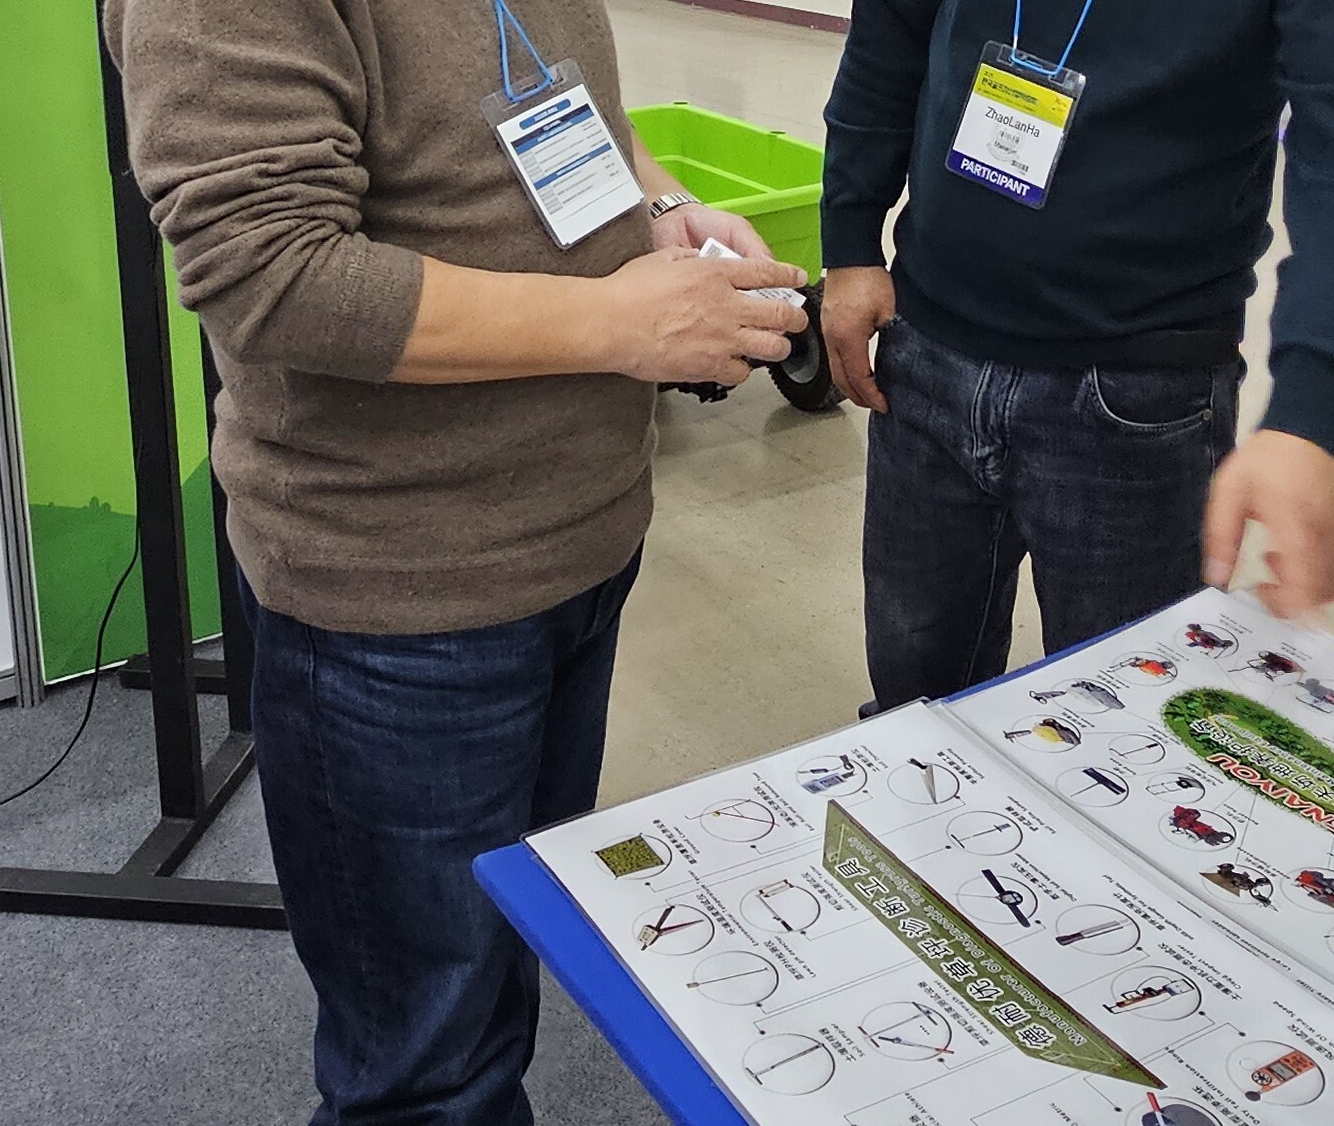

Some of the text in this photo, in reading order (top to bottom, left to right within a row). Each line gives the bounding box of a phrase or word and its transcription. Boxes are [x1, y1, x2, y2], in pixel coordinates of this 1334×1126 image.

[960, 158, 1031, 197] PARTICIPANT
[844, 835, 879, 862] Tools
[871, 860, 928, 905] Turfgrass
[724, 912, 760, 946] Environmental
[772, 935, 796, 956] detector
[920, 903, 988, 958] Diagnostic
[761, 939, 806, 980] 草坪PH检测仪
[831, 856, 1058, 1051] 德耐优草坪诊断工具
[1175, 943, 1243, 990] Clegg Impact Tester
[800, 964, 817, 978] Lawn
[931, 978, 995, 1036] Shear Strength Tester
[997, 972, 1088, 1046] Manufacturer
[1271, 999, 1297, 1017] Speed
[1294, 1017, 1317, 1033] Wind
[1315, 1033, 1328, 1041] Of
[817, 1026, 857, 1063] 土壤取样器
[850, 1045, 866, 1057] Soil
[1162, 1045, 1186, 1063] Rings
[1182, 1062, 1225, 1097] Infiltration
[1239, 1108, 1261, 1125] Duty
